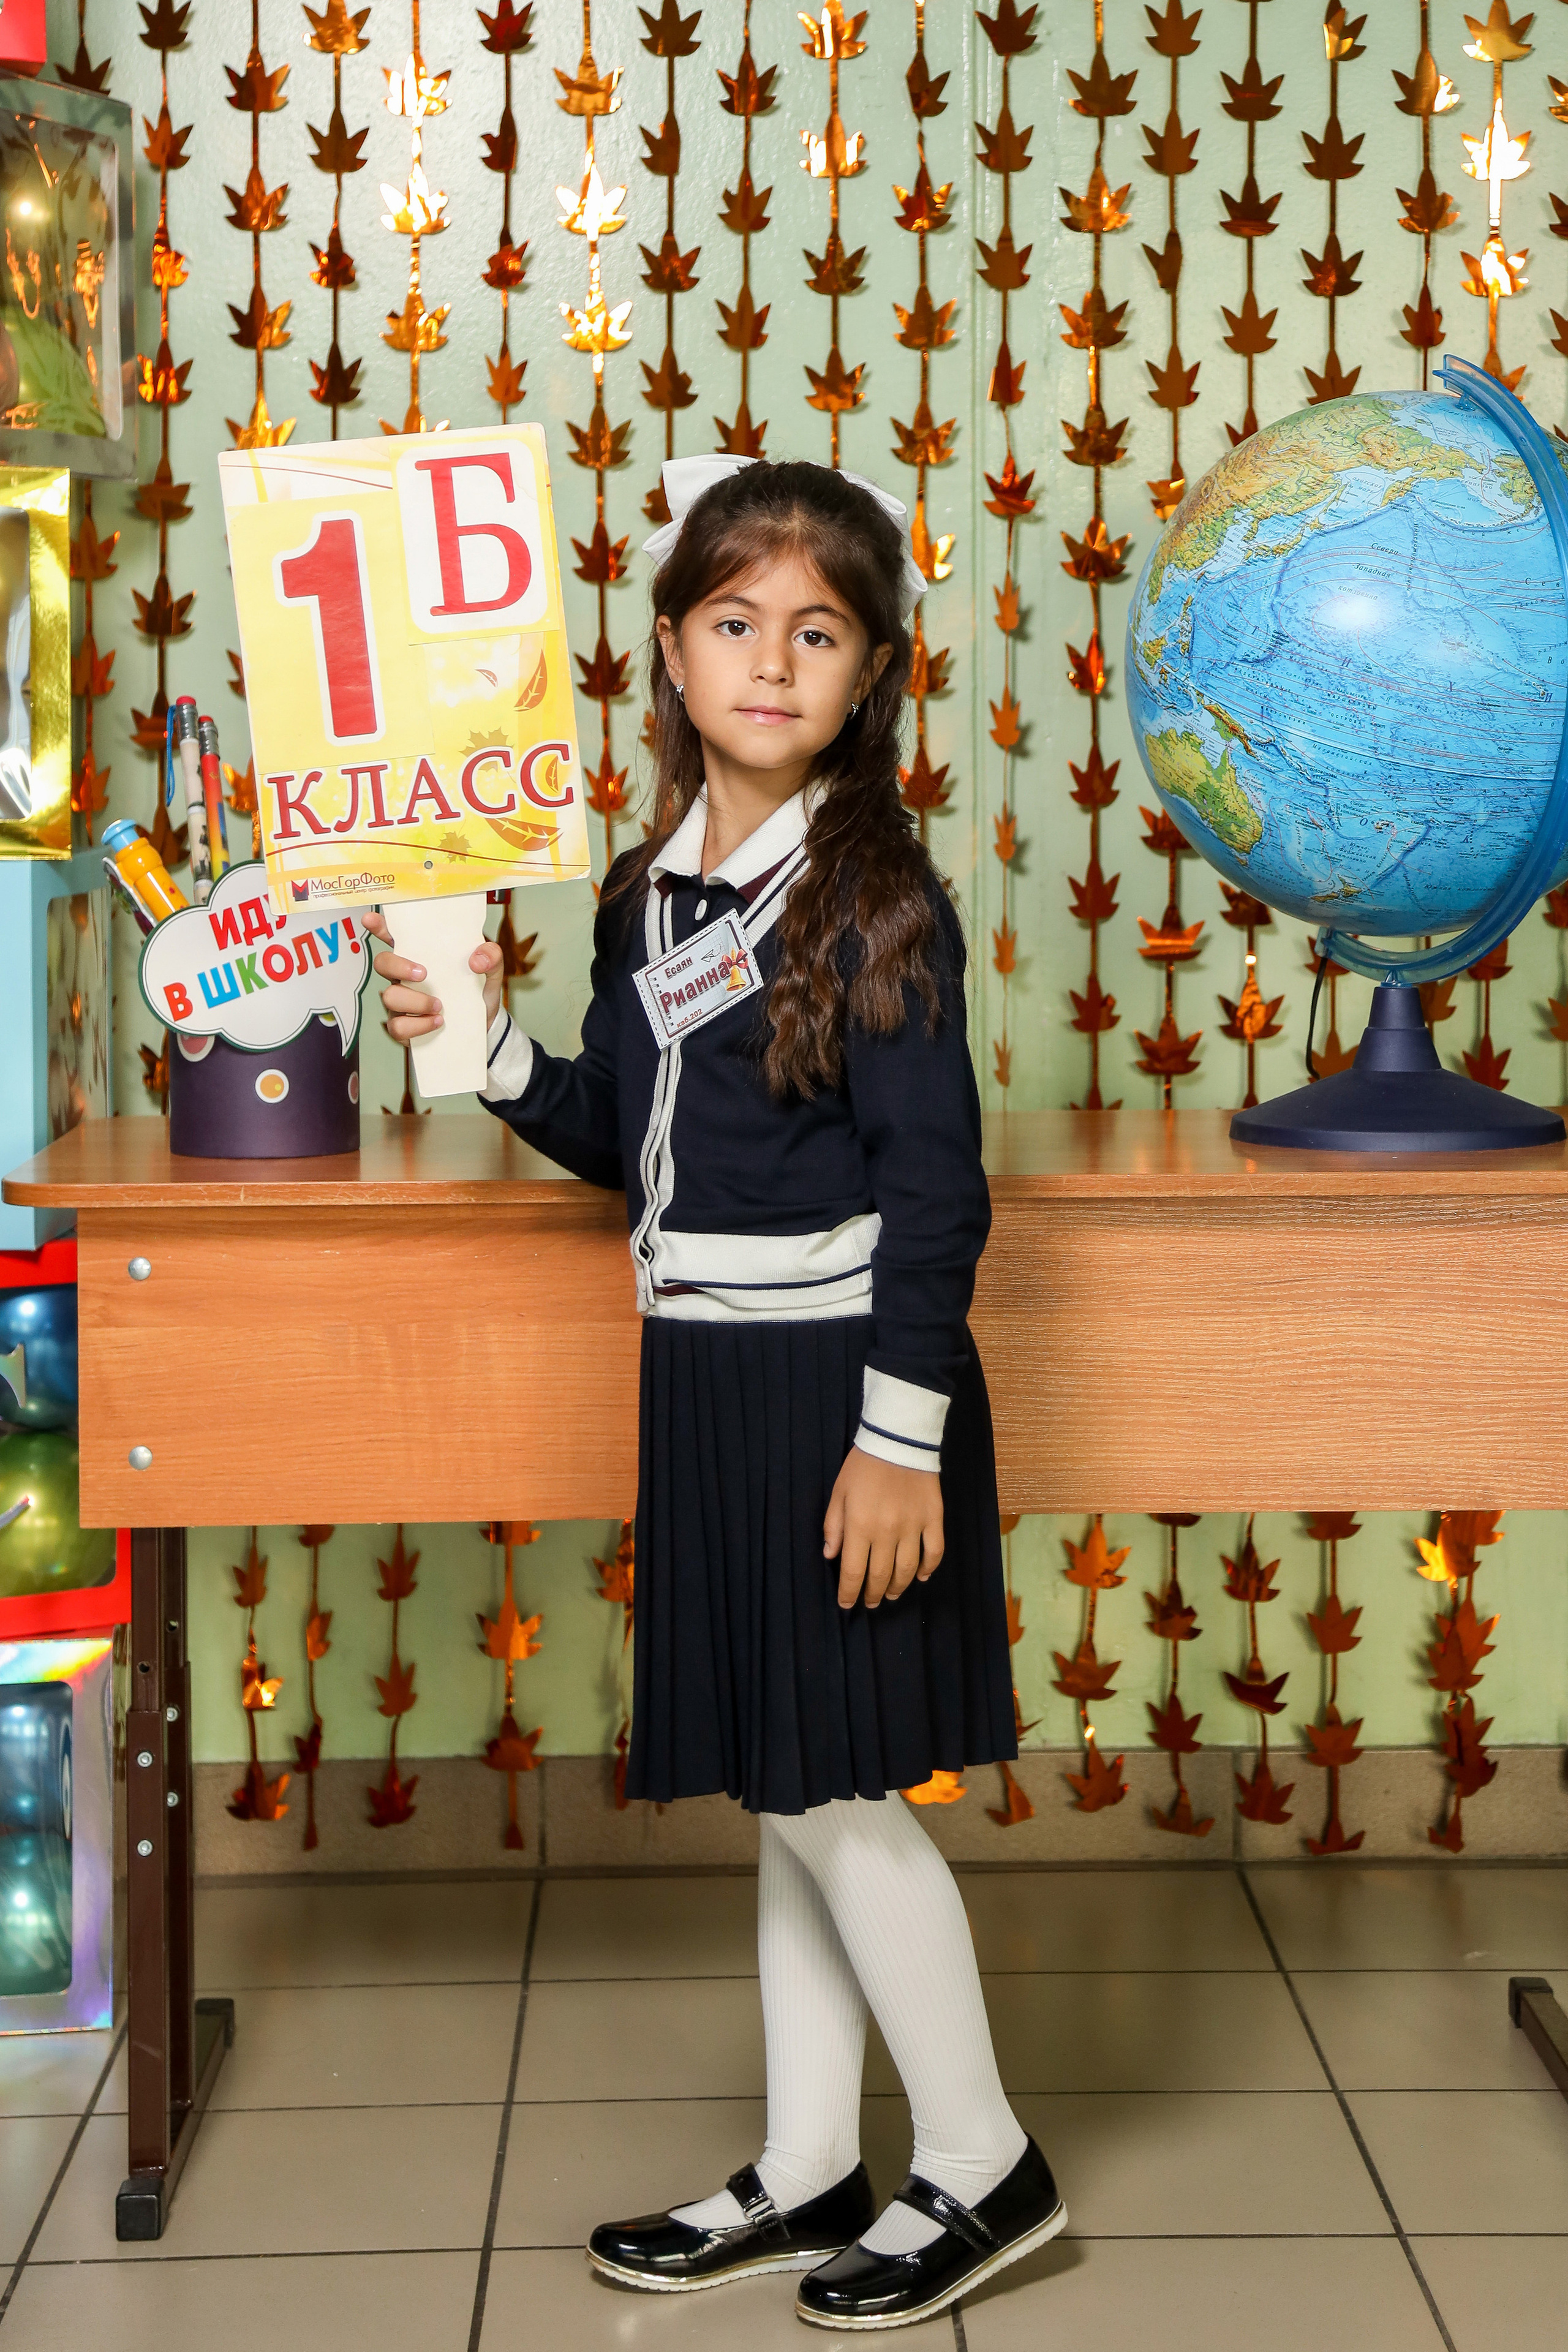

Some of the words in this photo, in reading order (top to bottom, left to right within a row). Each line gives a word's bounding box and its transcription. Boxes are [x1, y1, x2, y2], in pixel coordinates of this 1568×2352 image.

[1371, 542, 1403, 556] Северо-
[1351, 563, 1392, 579] -Западная
[281, 518, 377, 737] 1
[415, 452, 532, 617] Б
[1338, 584, 1379, 601] котловина
[267, 744, 574, 840] КЛАСС
[311, 872, 394, 891] МосГорФото
[164, 981, 193, 1022] В
[197, 916, 361, 1009] ШКОЛУ!
[665, 957, 693, 978] Есаян
[660, 961, 730, 1014] Рианна
